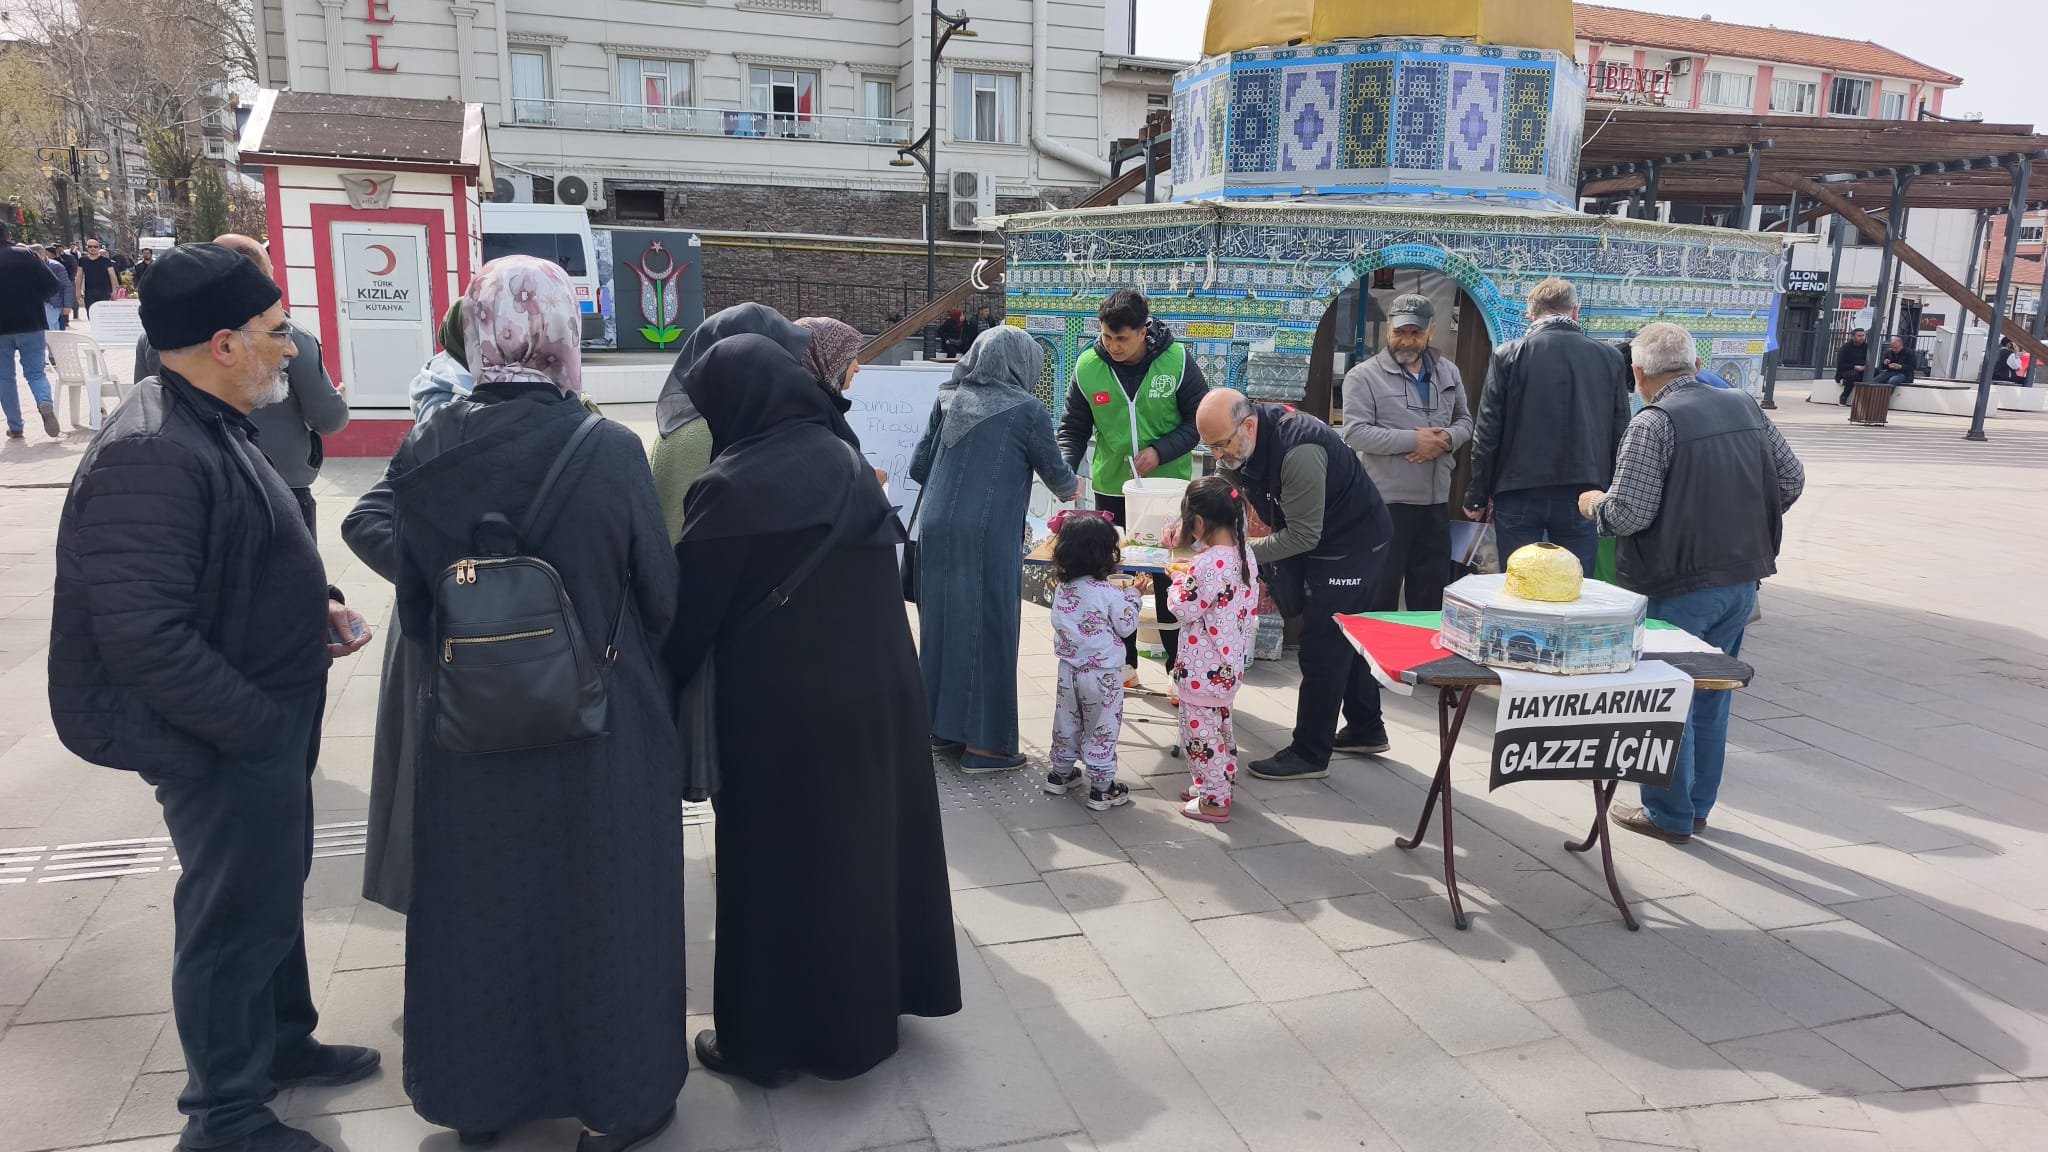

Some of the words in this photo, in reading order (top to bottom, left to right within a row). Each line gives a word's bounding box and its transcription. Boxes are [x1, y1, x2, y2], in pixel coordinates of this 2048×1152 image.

[1605, 62, 1672, 95] BENLİ
[1789, 271, 1818, 280] ALON
[372, 279, 393, 287] TÜRK
[357, 288, 409, 300] KIZILAY
[365, 303, 404, 311] KÜTAHYA
[1328, 577, 1361, 586] HAYRAT
[1507, 687, 1676, 720] HAYIRLARINIZ
[1499, 738, 1600, 775] GAZZE
[1604, 729, 1674, 777] İÇİN
